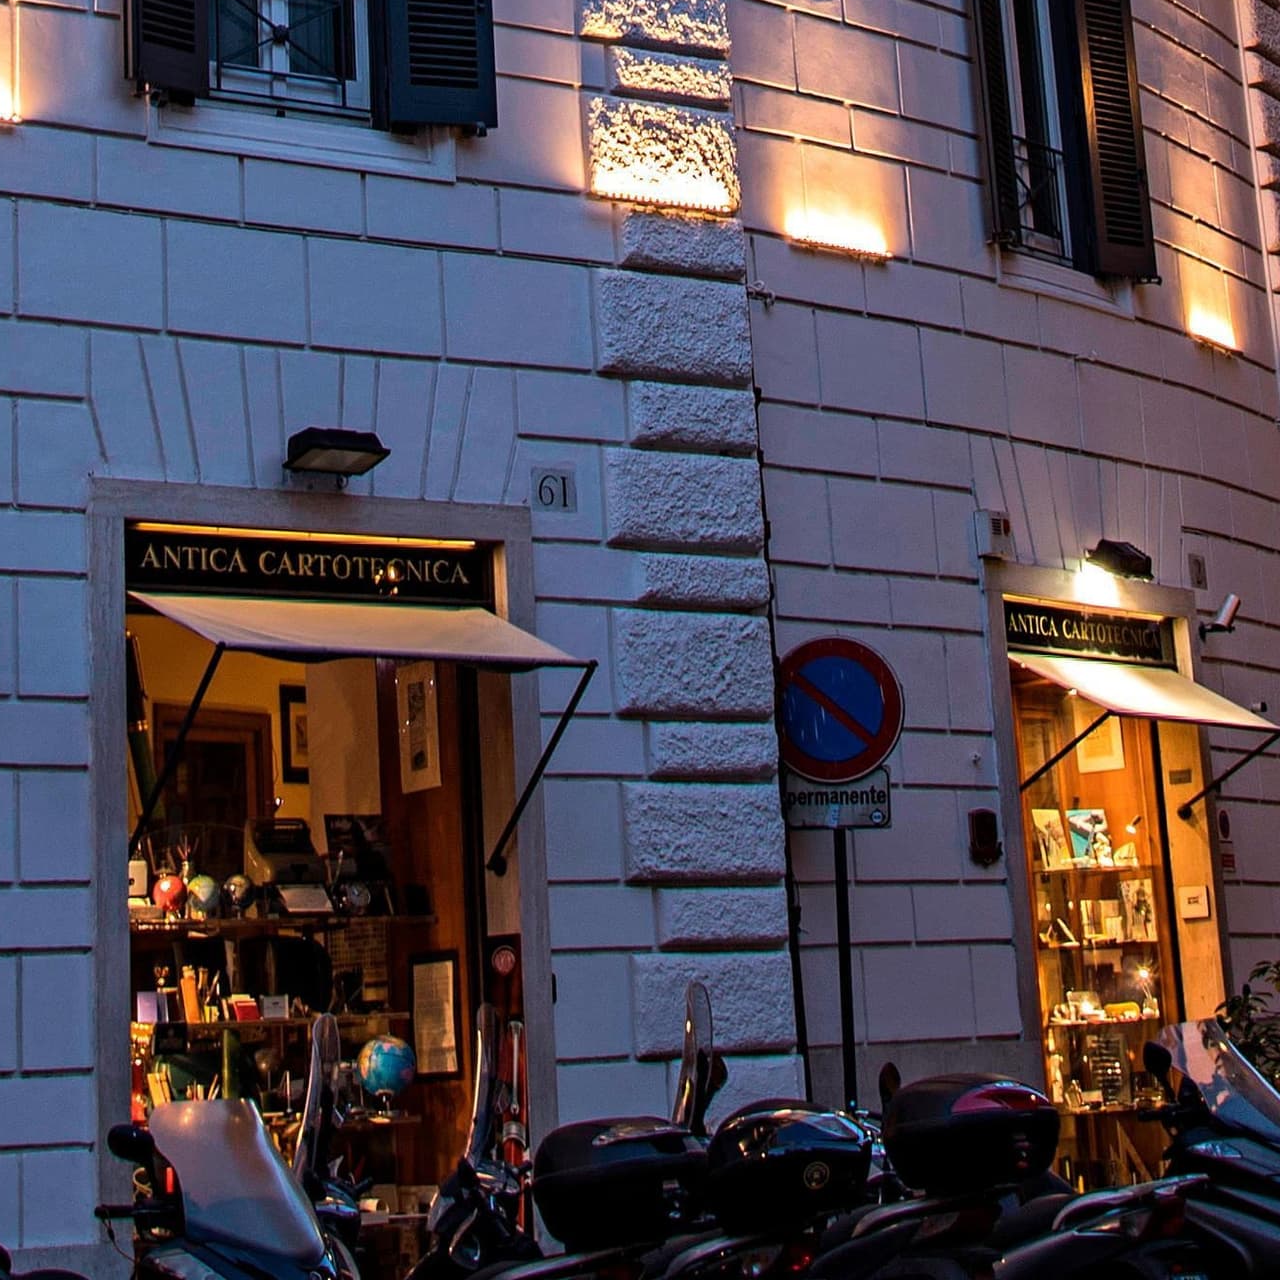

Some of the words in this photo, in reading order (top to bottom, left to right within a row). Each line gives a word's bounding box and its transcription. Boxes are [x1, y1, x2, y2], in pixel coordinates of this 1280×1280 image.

[539, 474, 568, 508] 61
[140, 542, 249, 573] ANTICA
[258, 549, 470, 585] CARTOTECNICA
[1008, 612, 1059, 637] ANTICA
[1061, 618, 1159, 649] CARTOTECNICA
[787, 785, 886, 808] permanente
